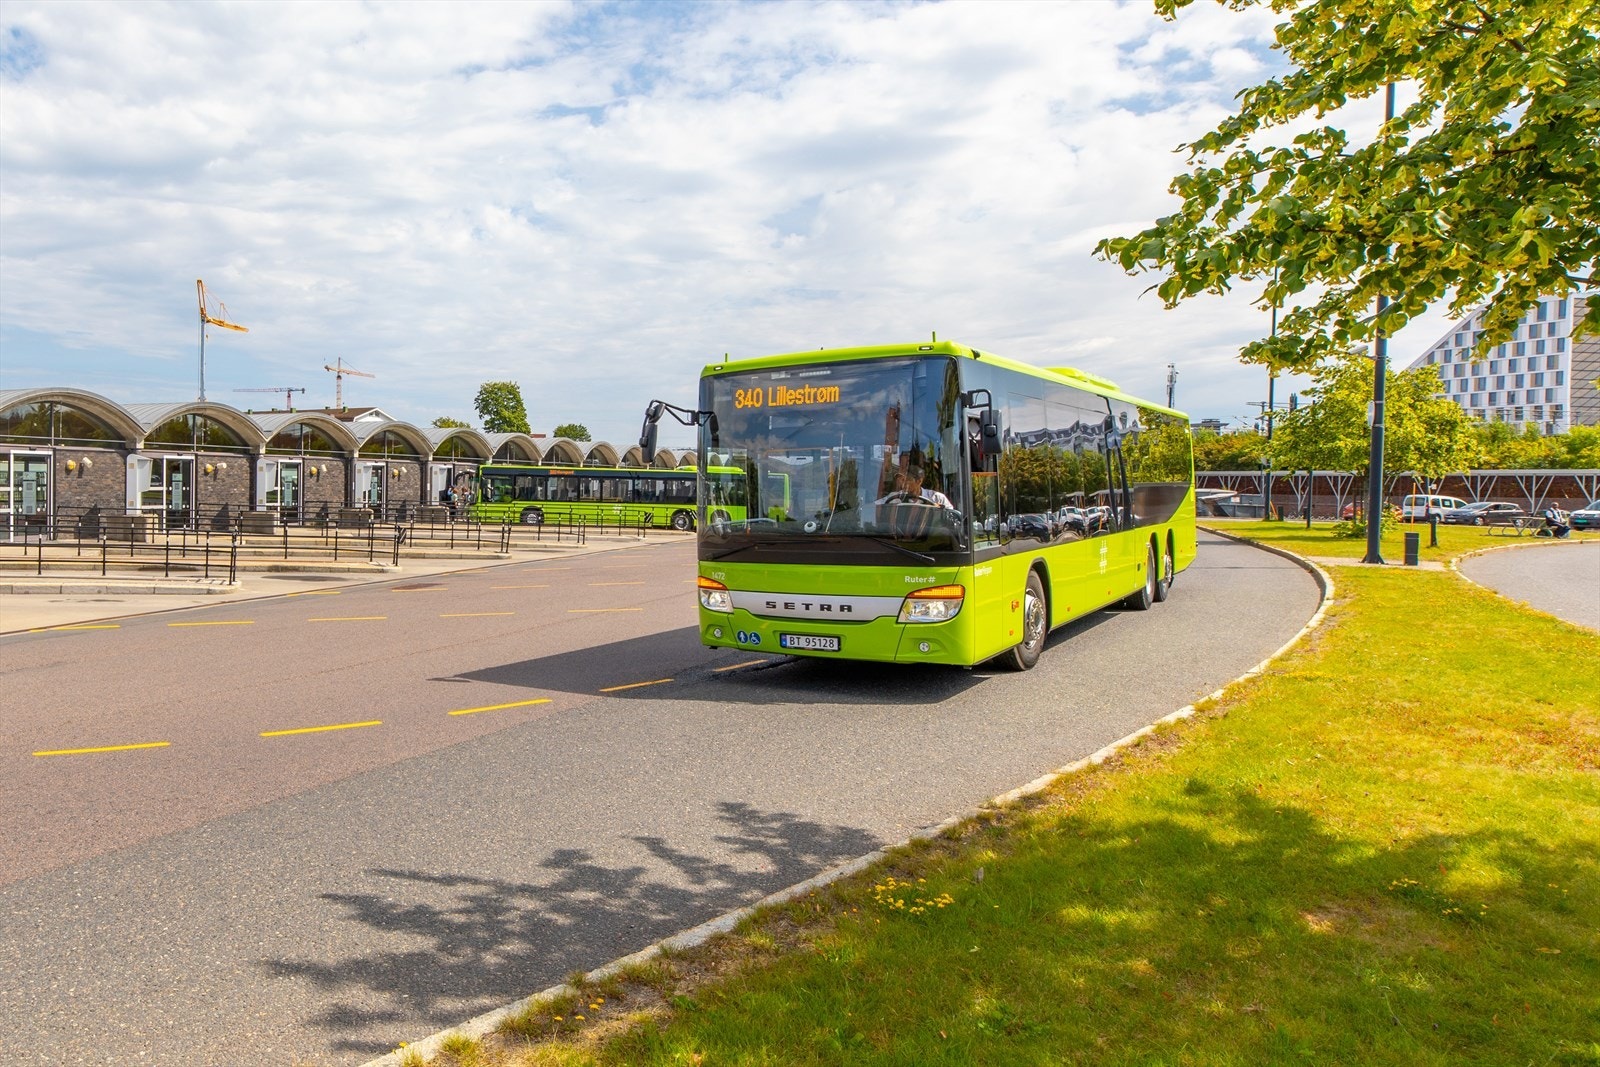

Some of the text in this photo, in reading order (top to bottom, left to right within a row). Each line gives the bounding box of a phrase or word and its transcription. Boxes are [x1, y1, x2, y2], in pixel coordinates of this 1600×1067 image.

[735, 384, 839, 409] 340 Lillestrøm
[765, 601, 853, 613] SETRA
[789, 636, 835, 648] BT 95128
